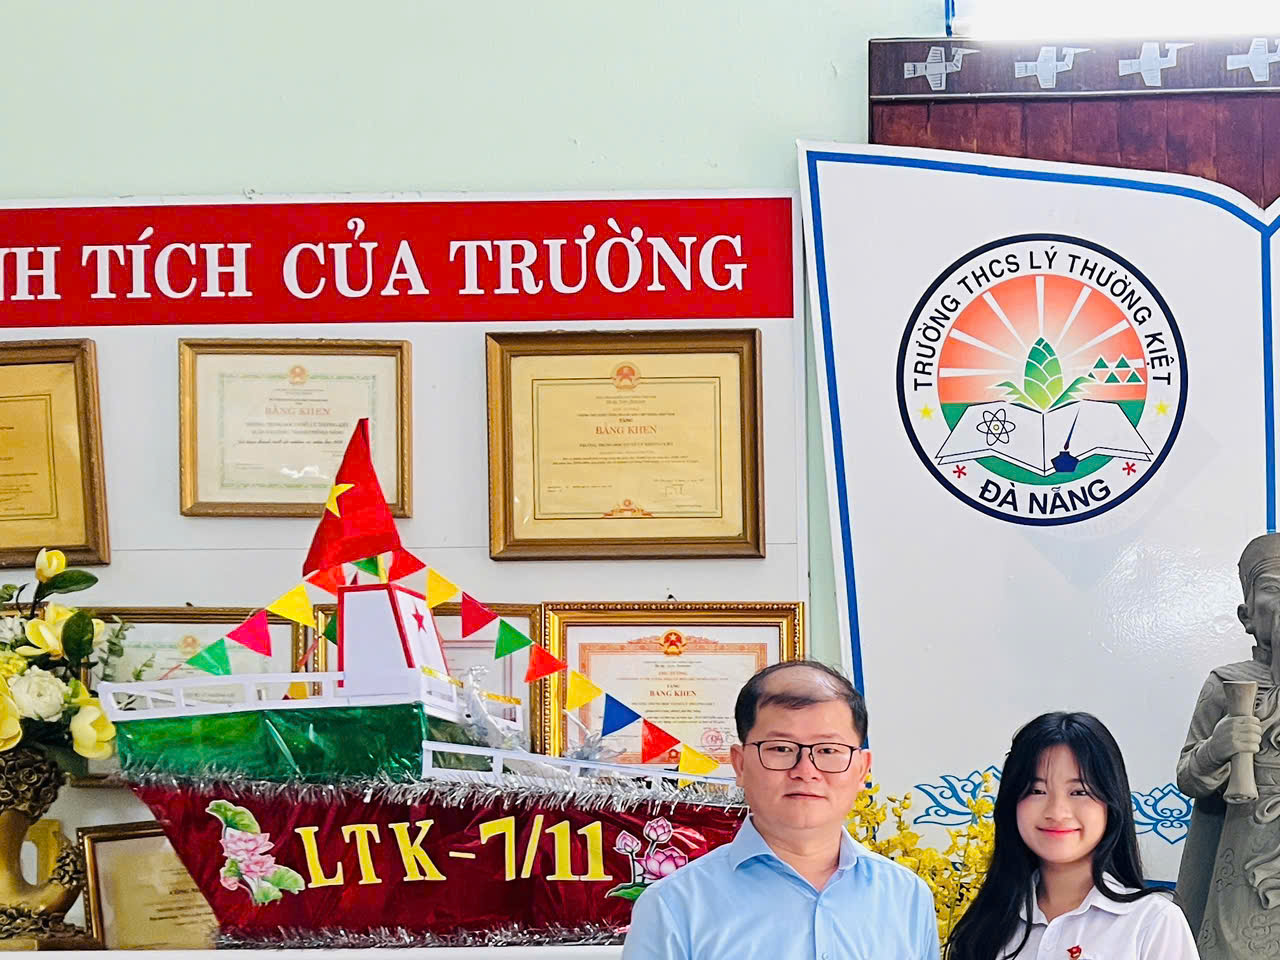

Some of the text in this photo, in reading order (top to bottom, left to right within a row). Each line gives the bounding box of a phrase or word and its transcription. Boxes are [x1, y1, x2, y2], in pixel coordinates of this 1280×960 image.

[81, 226, 252, 300] TÍCH
[282, 217, 429, 300] CỦA
[449, 217, 749, 296] TRƯỜNG
[914, 246, 1176, 391] TRƯỜNG THCS LÝ THƯỜNG KIỆT
[299, 407, 330, 416] KHEN
[627, 424, 657, 435] KHEN
[979, 478, 1112, 515] ĐÀ NẴNG
